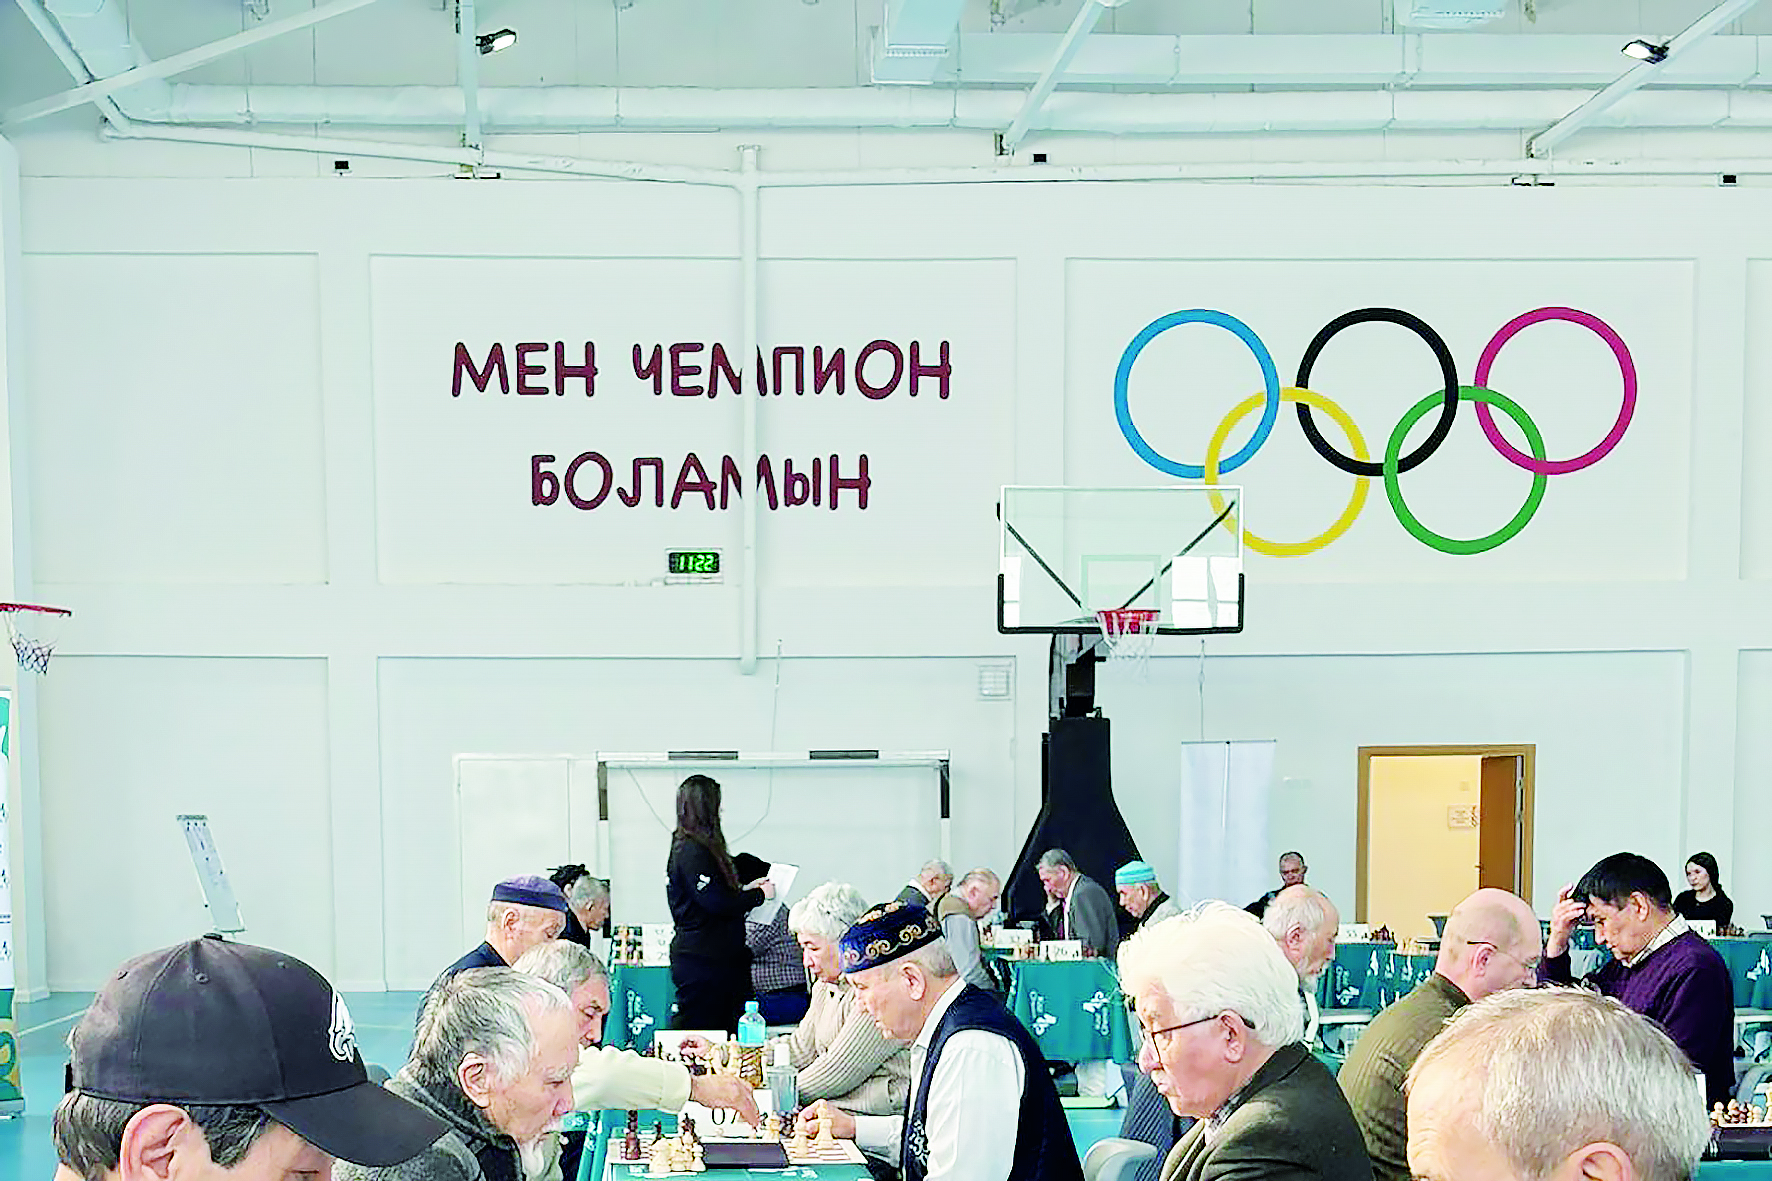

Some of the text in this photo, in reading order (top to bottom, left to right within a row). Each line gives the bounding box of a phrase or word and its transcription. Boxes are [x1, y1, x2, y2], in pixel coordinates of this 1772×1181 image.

[451, 340, 951, 400] МЕН ЧЕМПИОН
[531, 451, 871, 510] БОЛАМЫН
